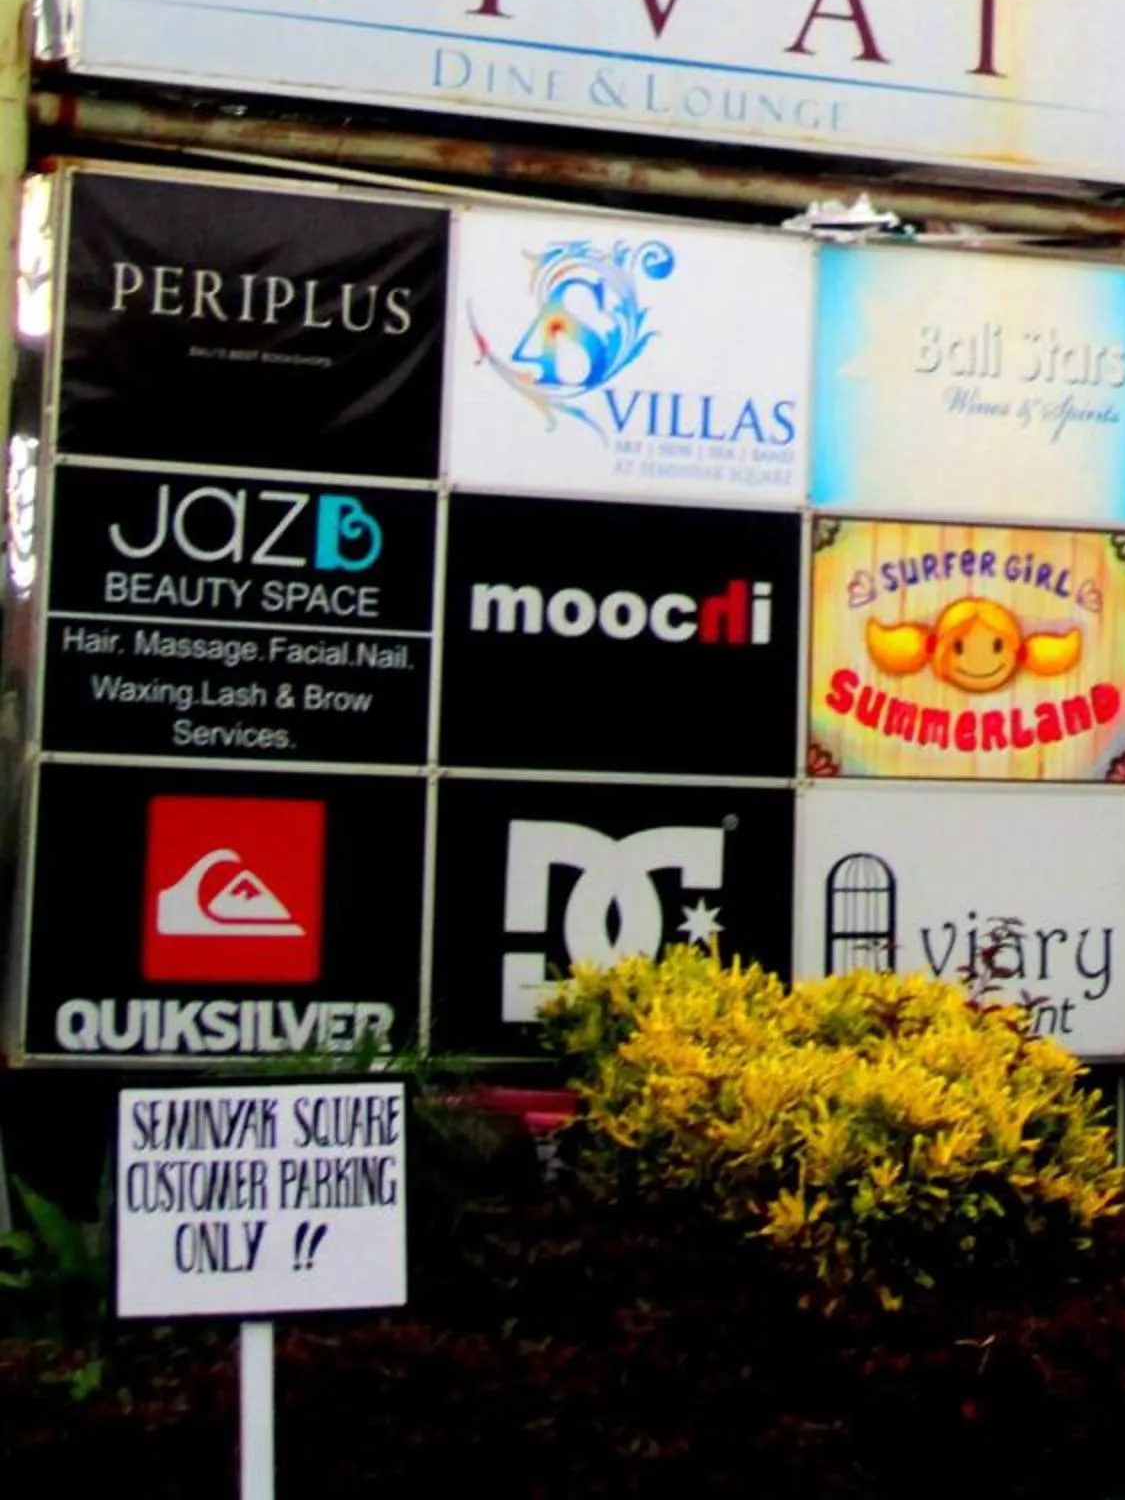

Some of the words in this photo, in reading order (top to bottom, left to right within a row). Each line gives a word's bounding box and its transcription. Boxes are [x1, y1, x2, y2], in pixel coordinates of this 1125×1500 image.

[431, 47, 568, 102] DINE
[111, 261, 412, 335] PERIPLUS
[915, 321, 1003, 379] Bali
[605, 388, 797, 446] VILLAS
[104, 570, 251, 609] BEAUTY
[260, 580, 380, 618] SPACE
[275, 683, 296, 709] &
[303, 683, 373, 712] Brow
[55, 997, 395, 1053] QUIKSILVER
[131, 1097, 279, 1151] SEMINYAK
[293, 1095, 400, 1148] SQUARE
[127, 1159, 268, 1213] CUSTOMER
[279, 1155, 398, 1210] PARKING
[174, 1220, 267, 1274] ONLY
